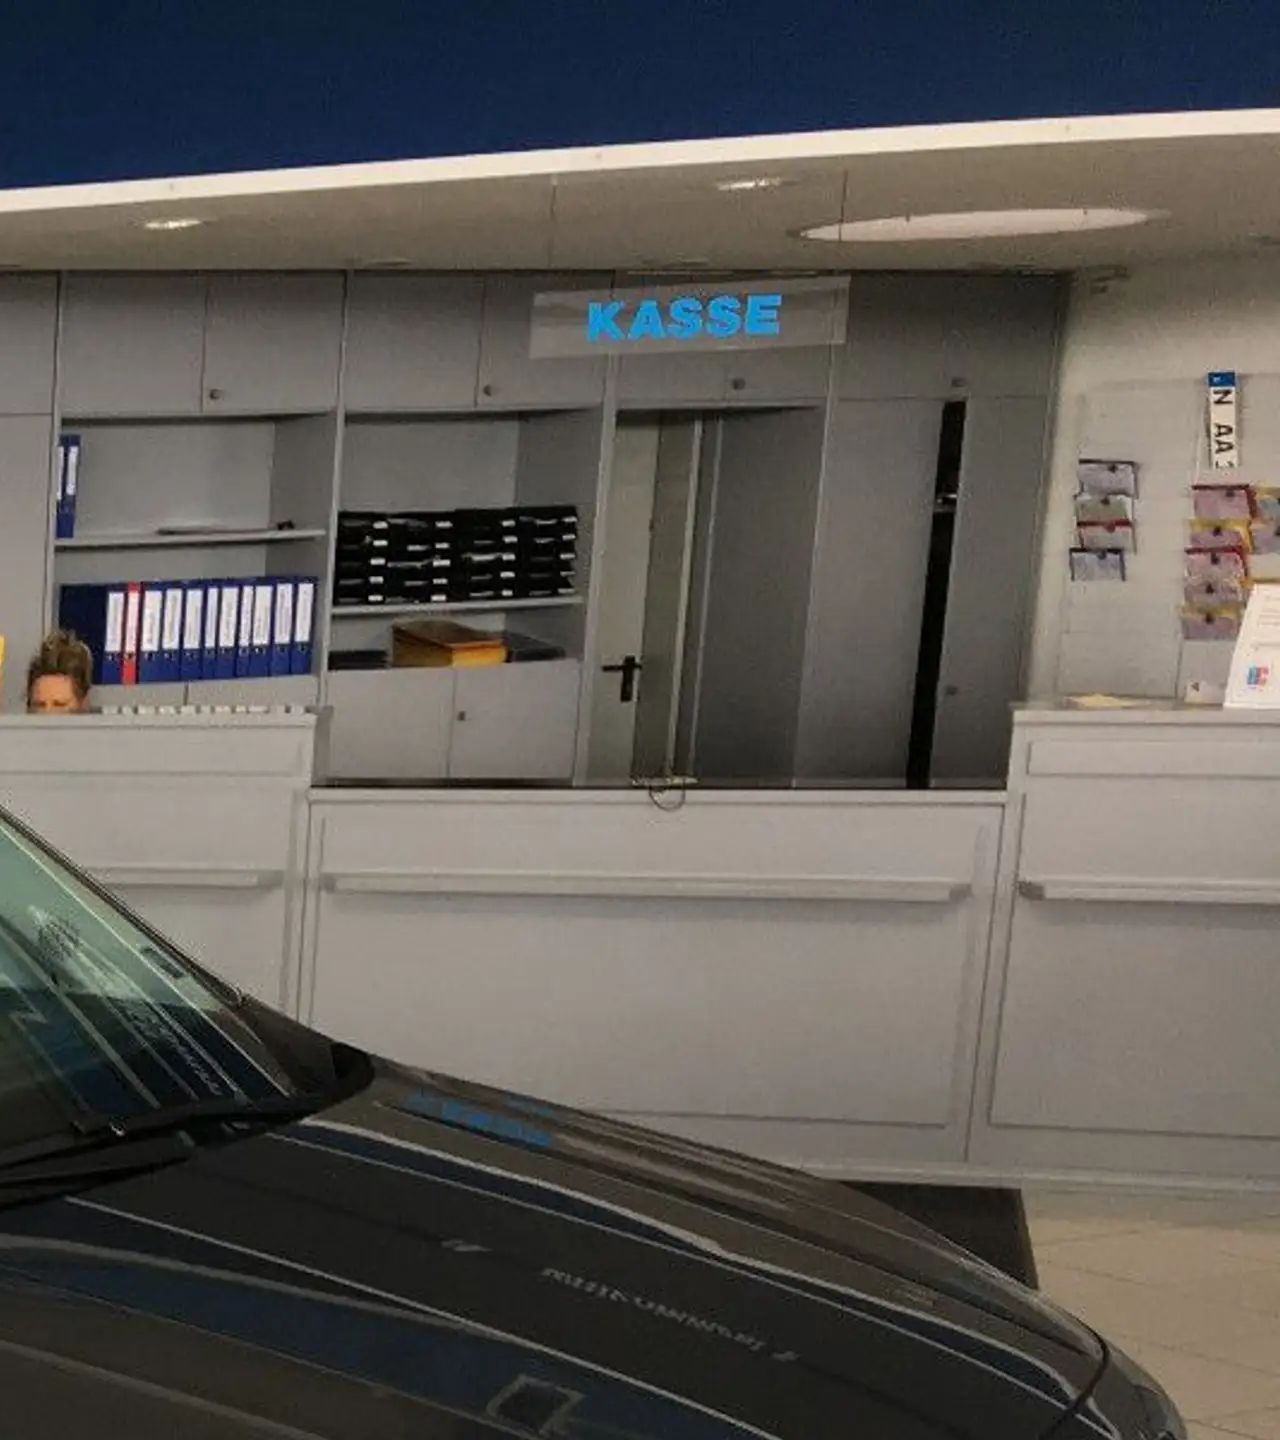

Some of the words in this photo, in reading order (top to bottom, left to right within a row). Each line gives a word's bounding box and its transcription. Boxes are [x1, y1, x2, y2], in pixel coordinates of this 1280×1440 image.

[587, 293, 782, 343] KASSE
[1213, 389, 1233, 404] N
[1214, 422, 1234, 454] AA
